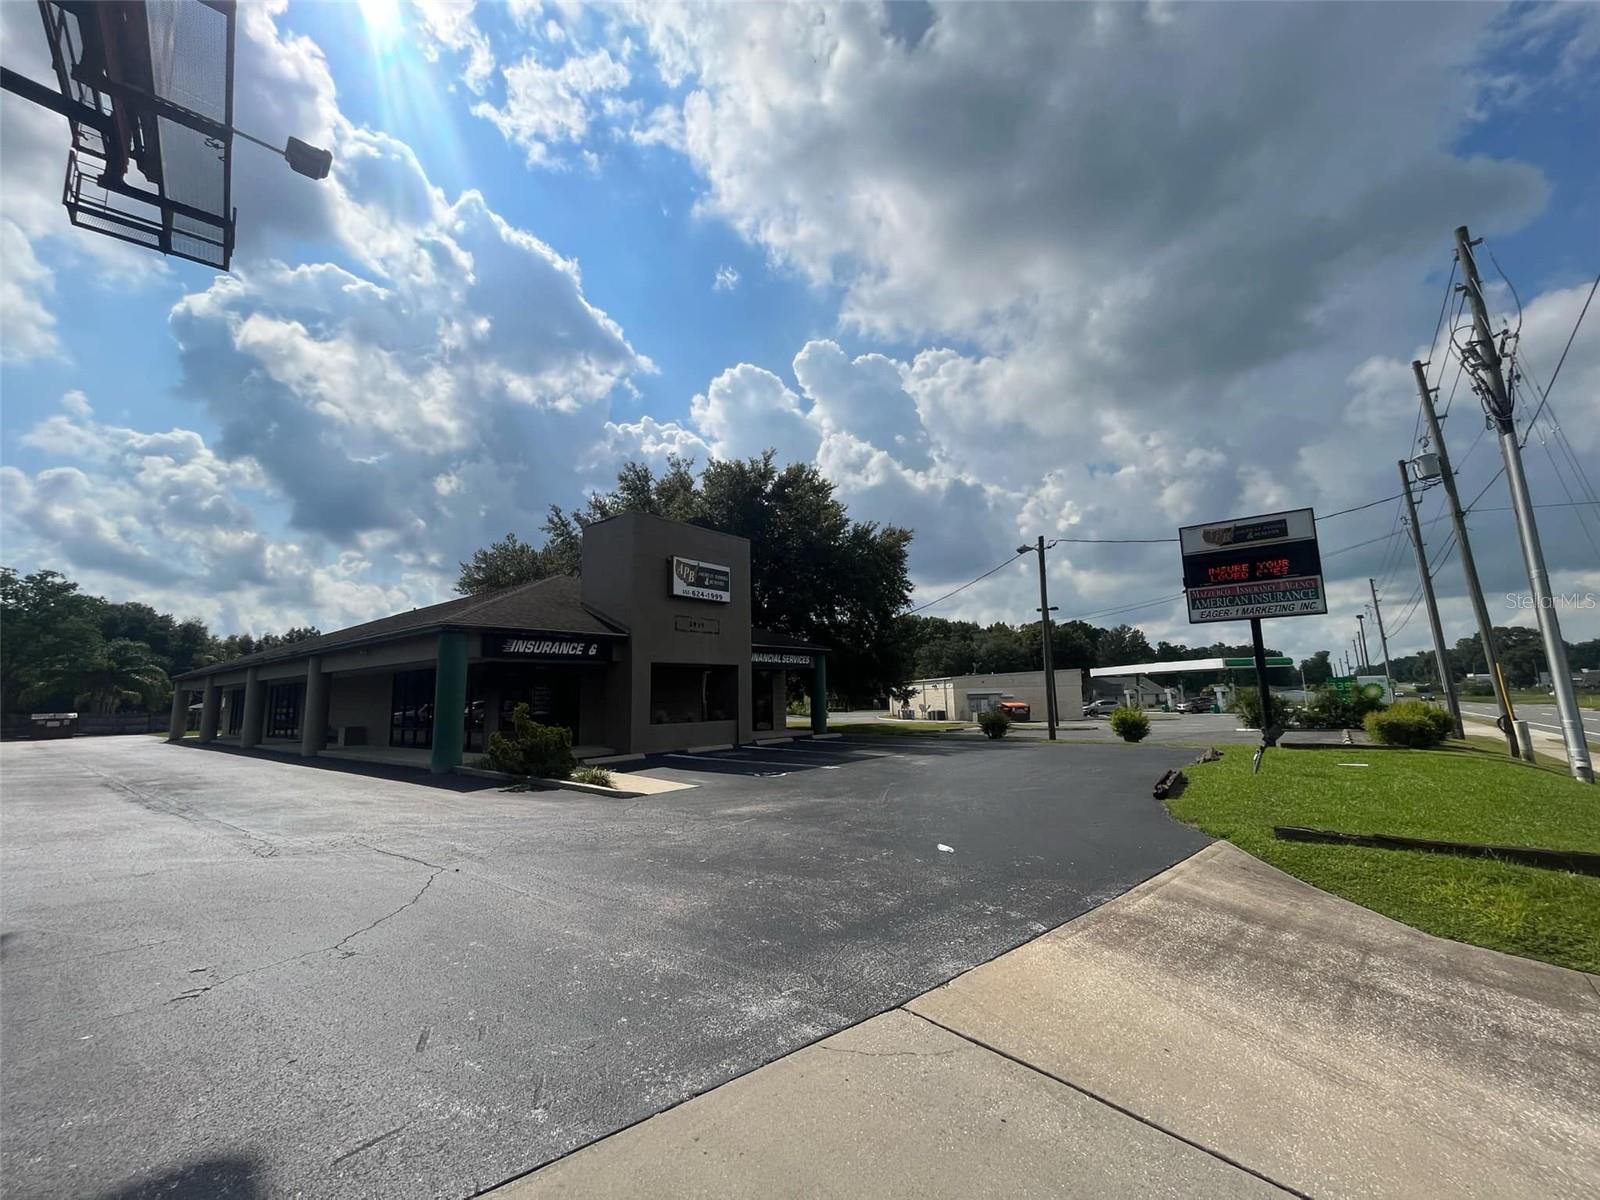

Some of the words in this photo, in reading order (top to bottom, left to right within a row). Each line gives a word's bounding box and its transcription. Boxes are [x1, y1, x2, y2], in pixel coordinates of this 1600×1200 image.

[1208, 563, 1249, 576] INSURE
[1256, 559, 1290, 570] YOUR
[1194, 595, 1248, 609] AMERICAN
[1251, 589, 1316, 604] INSURANCE
[1241, 603, 1296, 616] MARKETING
[510, 639, 585, 655] INSURANCE
[588, 643, 598, 655] &
[782, 654, 810, 664] SERVICES
